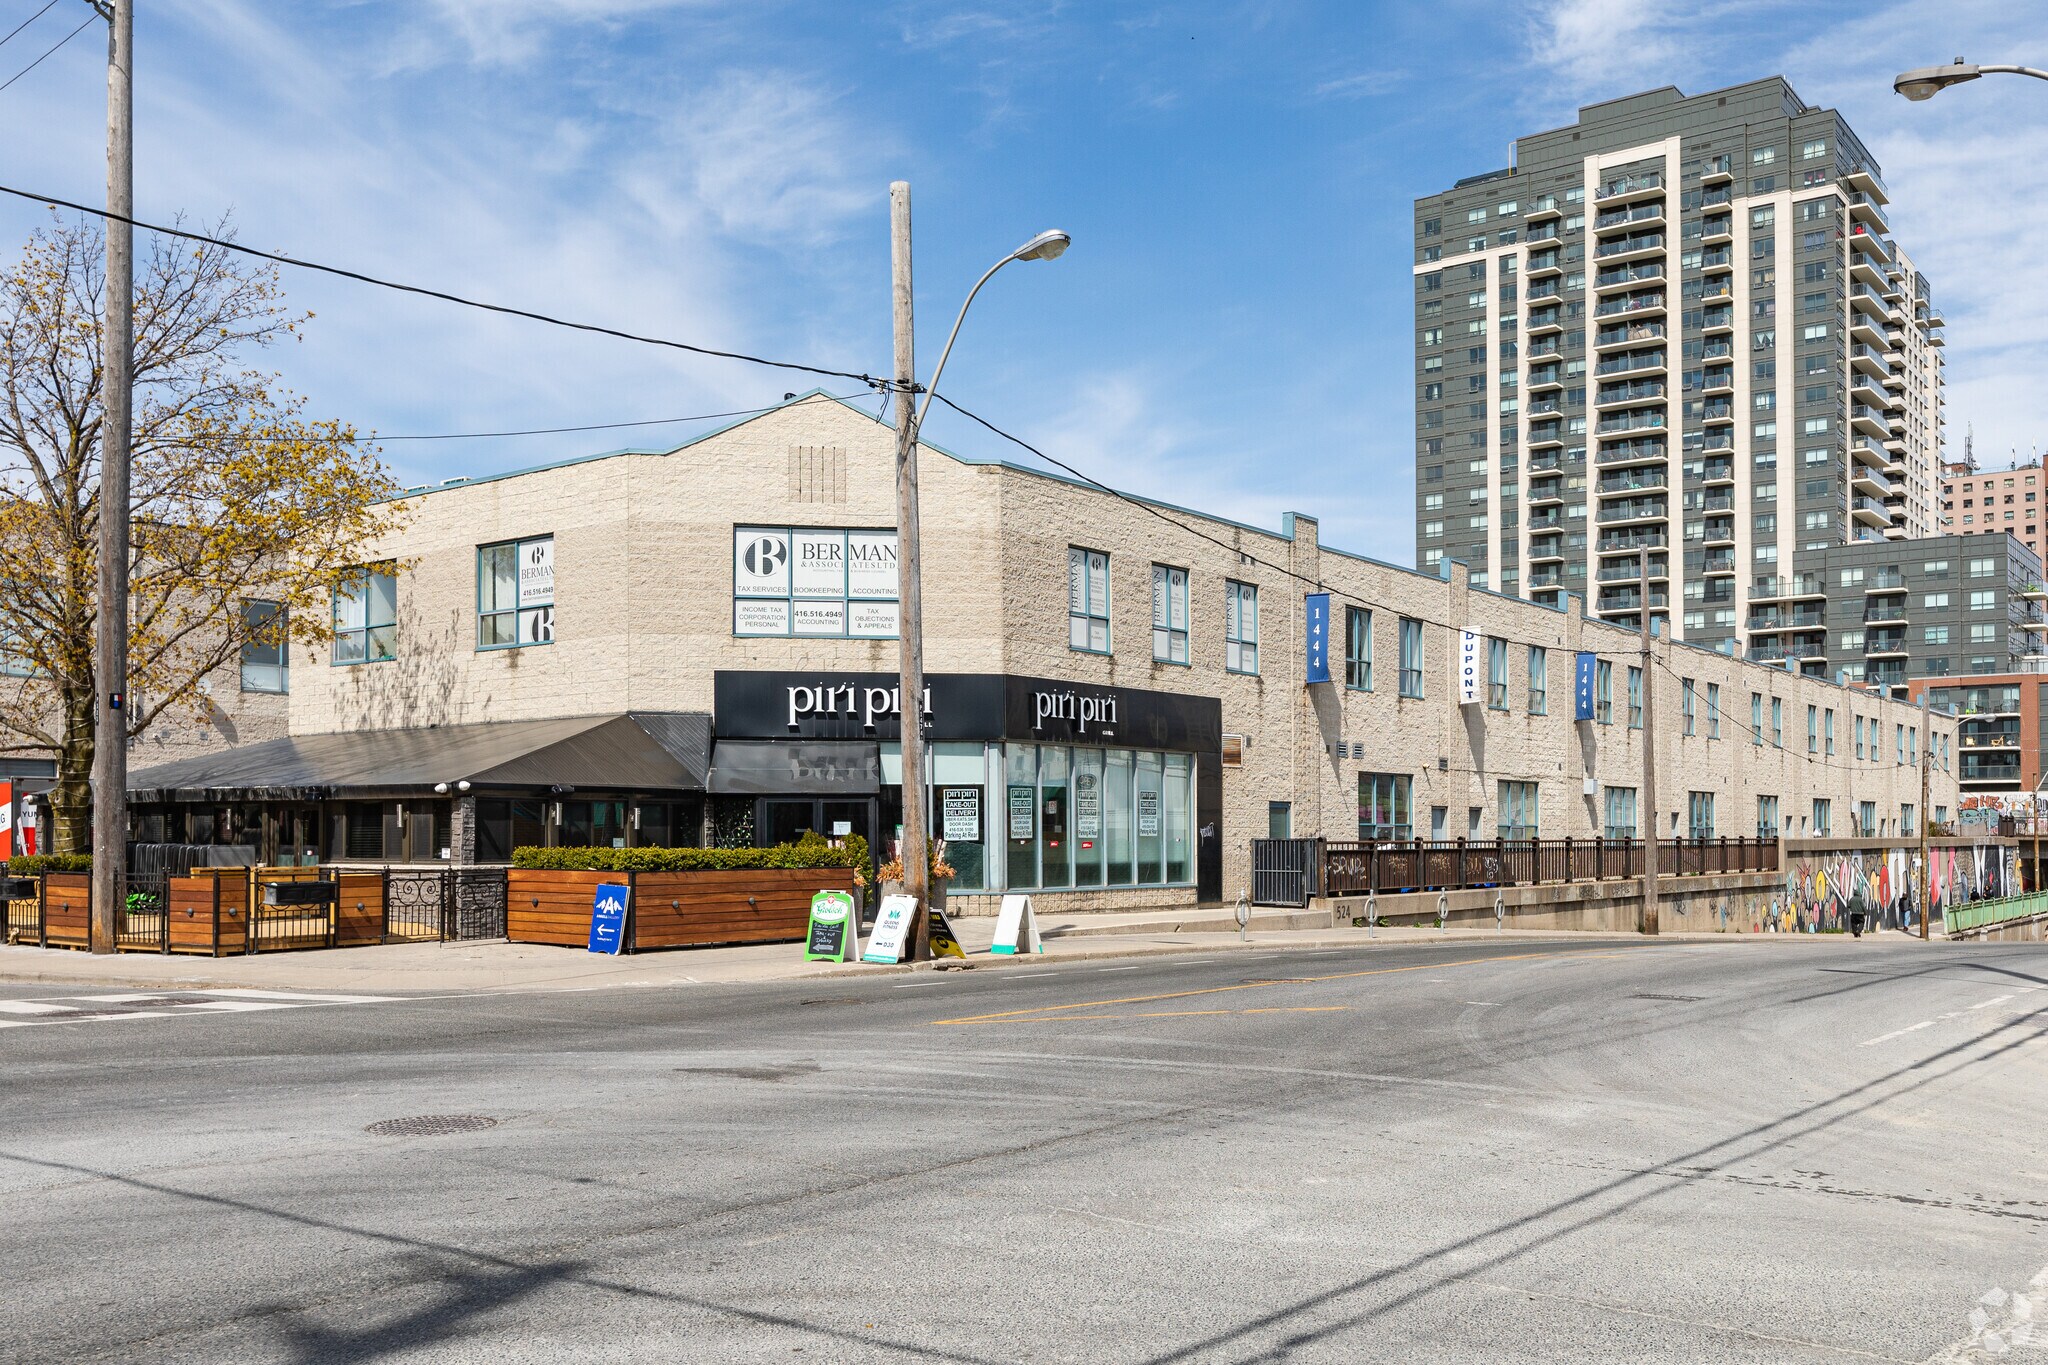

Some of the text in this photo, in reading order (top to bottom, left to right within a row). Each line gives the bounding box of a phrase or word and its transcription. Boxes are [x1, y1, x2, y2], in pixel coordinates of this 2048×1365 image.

[794, 610, 843, 618] 416.516.4949
[1464, 631, 1475, 699] DUPONT
[863, 682, 933, 727] pii
[1035, 688, 1117, 733] piri piri
[1337, 905, 1351, 920] 524
